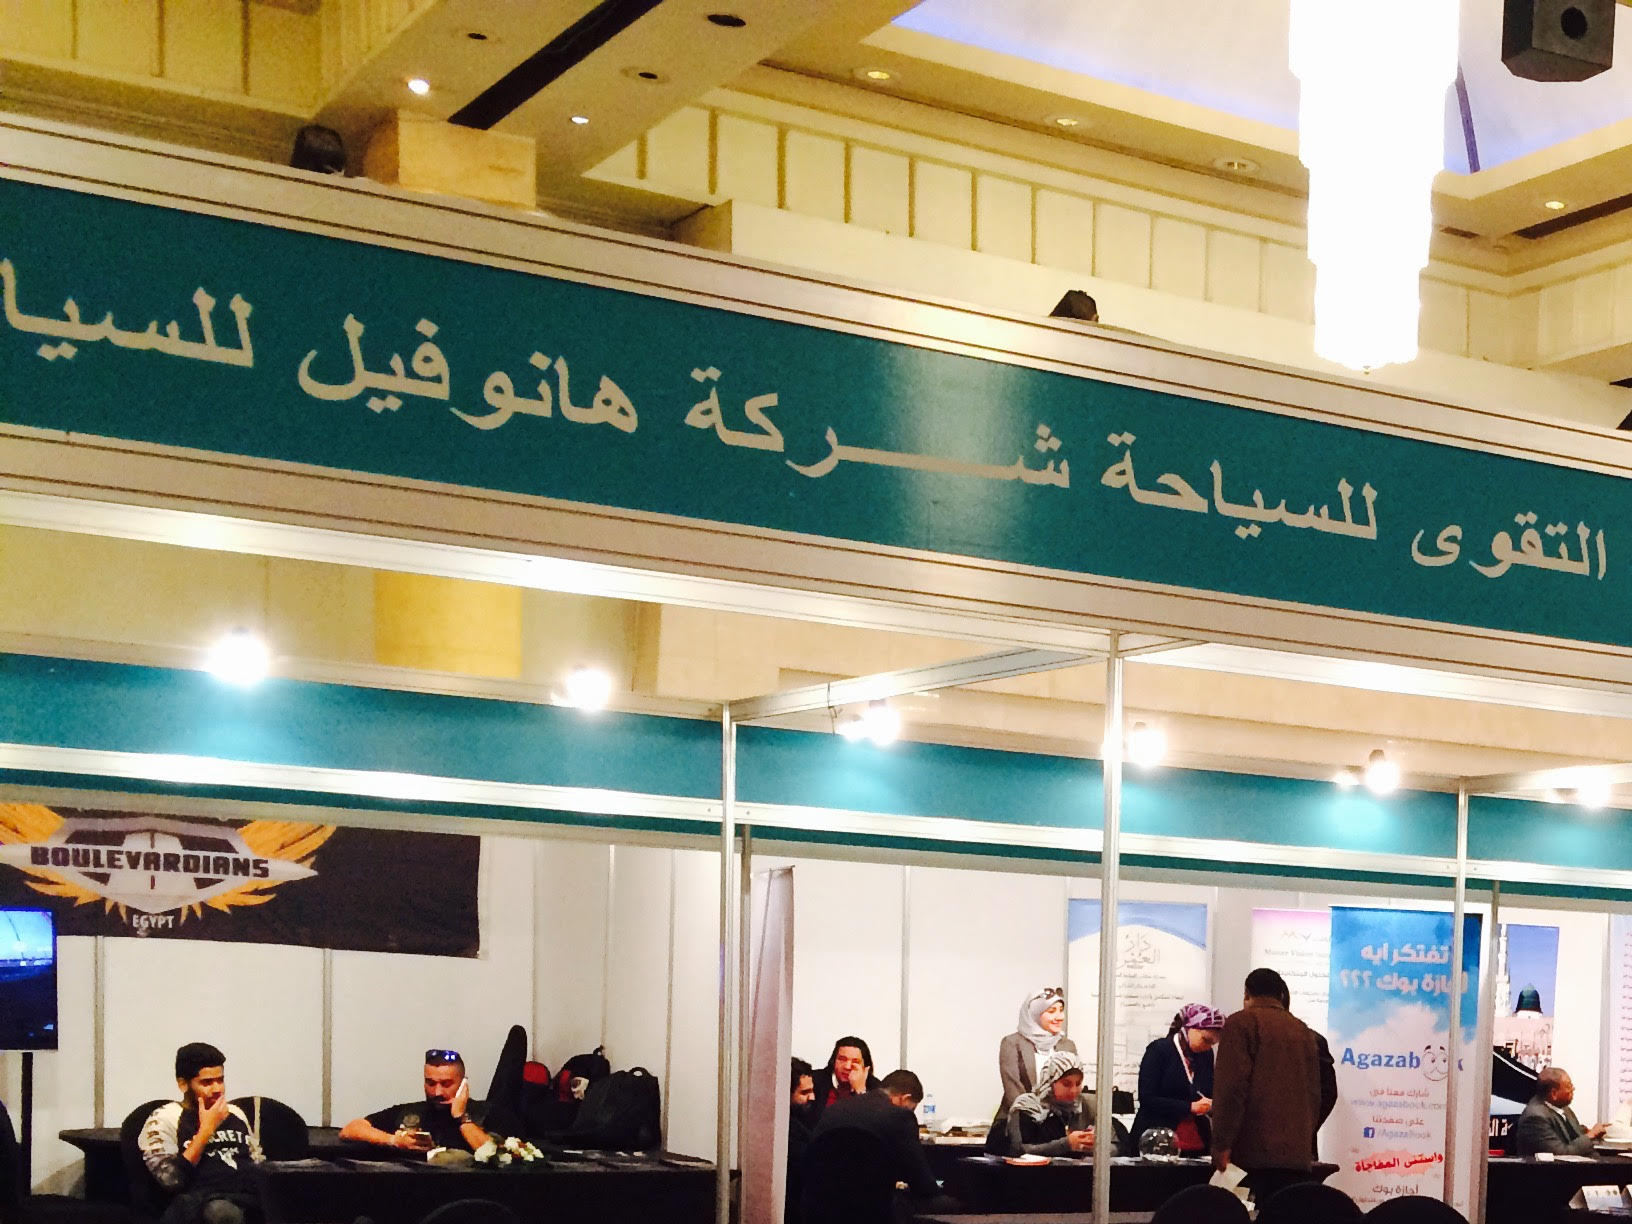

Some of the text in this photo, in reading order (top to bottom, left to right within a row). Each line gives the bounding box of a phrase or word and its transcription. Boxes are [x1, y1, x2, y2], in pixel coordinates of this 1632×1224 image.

[299, 314, 637, 433] هانوفيل
[686, 366, 1071, 489] شركة
[1101, 430, 1377, 541] للسياحة
[1411, 509, 1608, 581] التقوى
[30, 846, 270, 878] BOULEVARDIANS
[132, 914, 175, 929] EGYPT
[1360, 942, 1450, 967] تفتكر ايه
[1375, 972, 1419, 996] بوك
[1421, 970, 1469, 997] اازة
